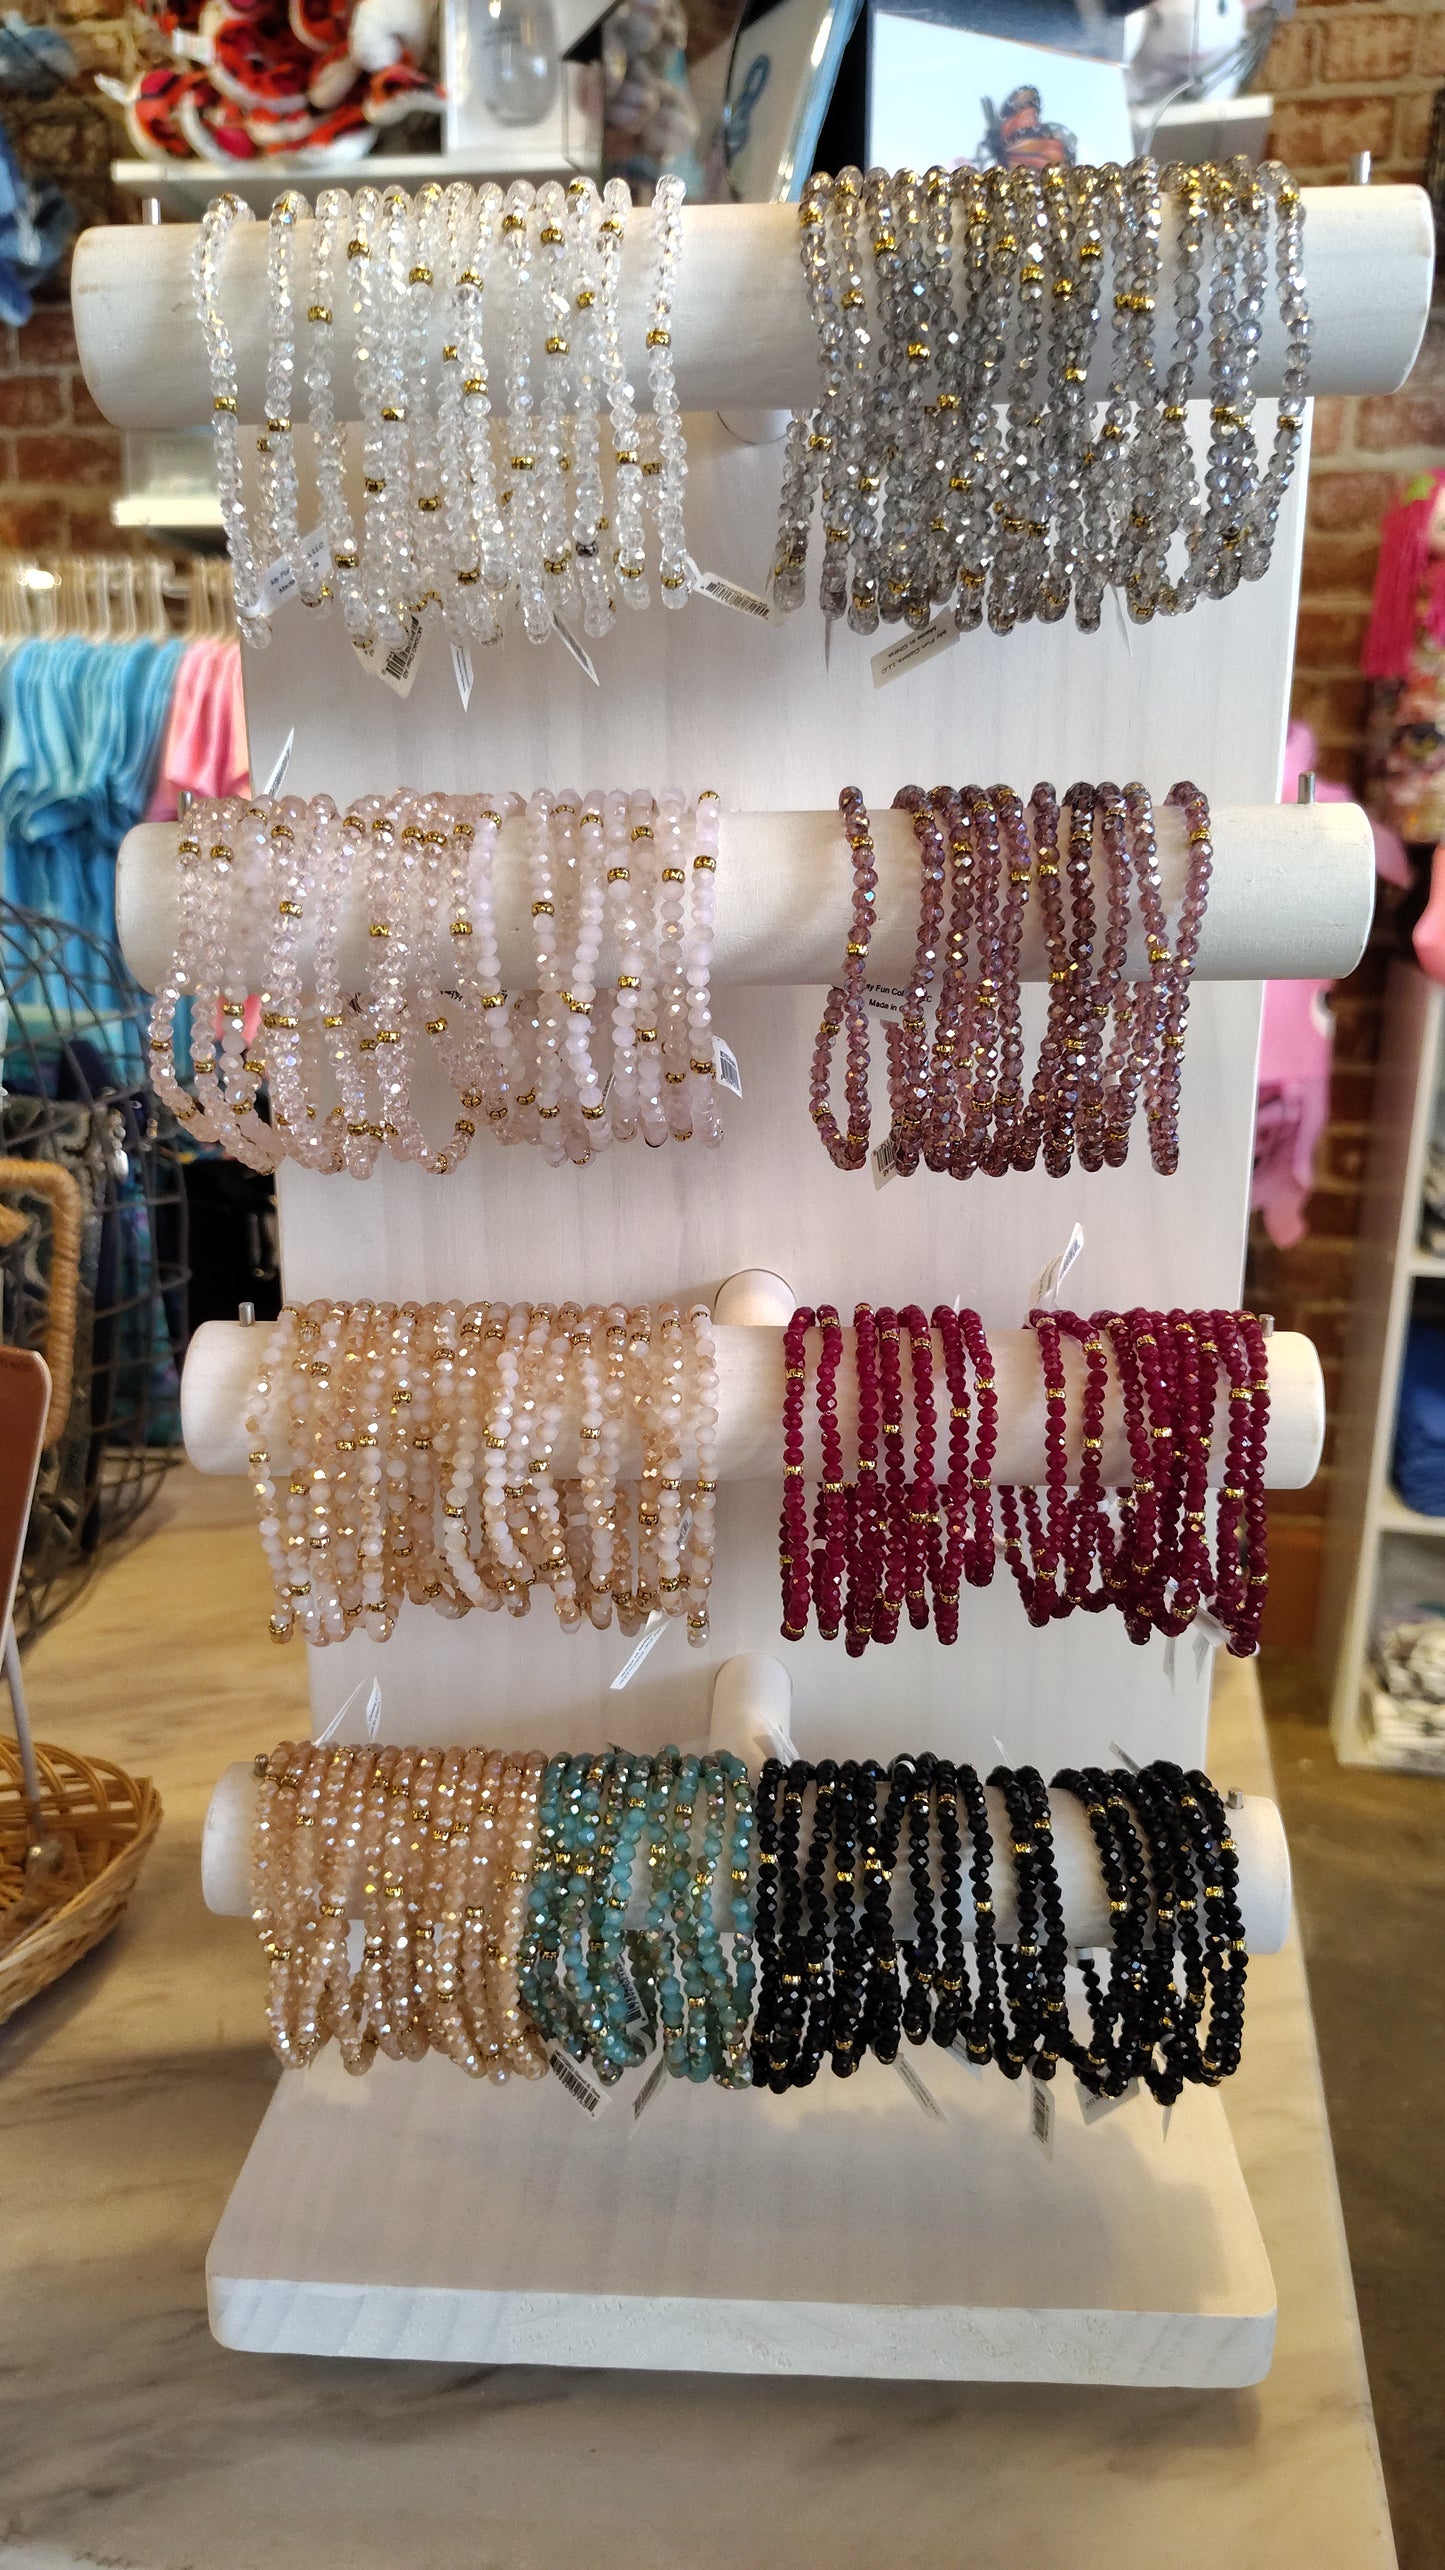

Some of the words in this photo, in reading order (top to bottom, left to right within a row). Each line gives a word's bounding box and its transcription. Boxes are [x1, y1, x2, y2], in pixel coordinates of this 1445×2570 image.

[921, 638, 935, 649] Fun
[875, 984, 890, 994] Fun
[868, 998, 889, 1009] Made
[890, 1003, 898, 1011] in
